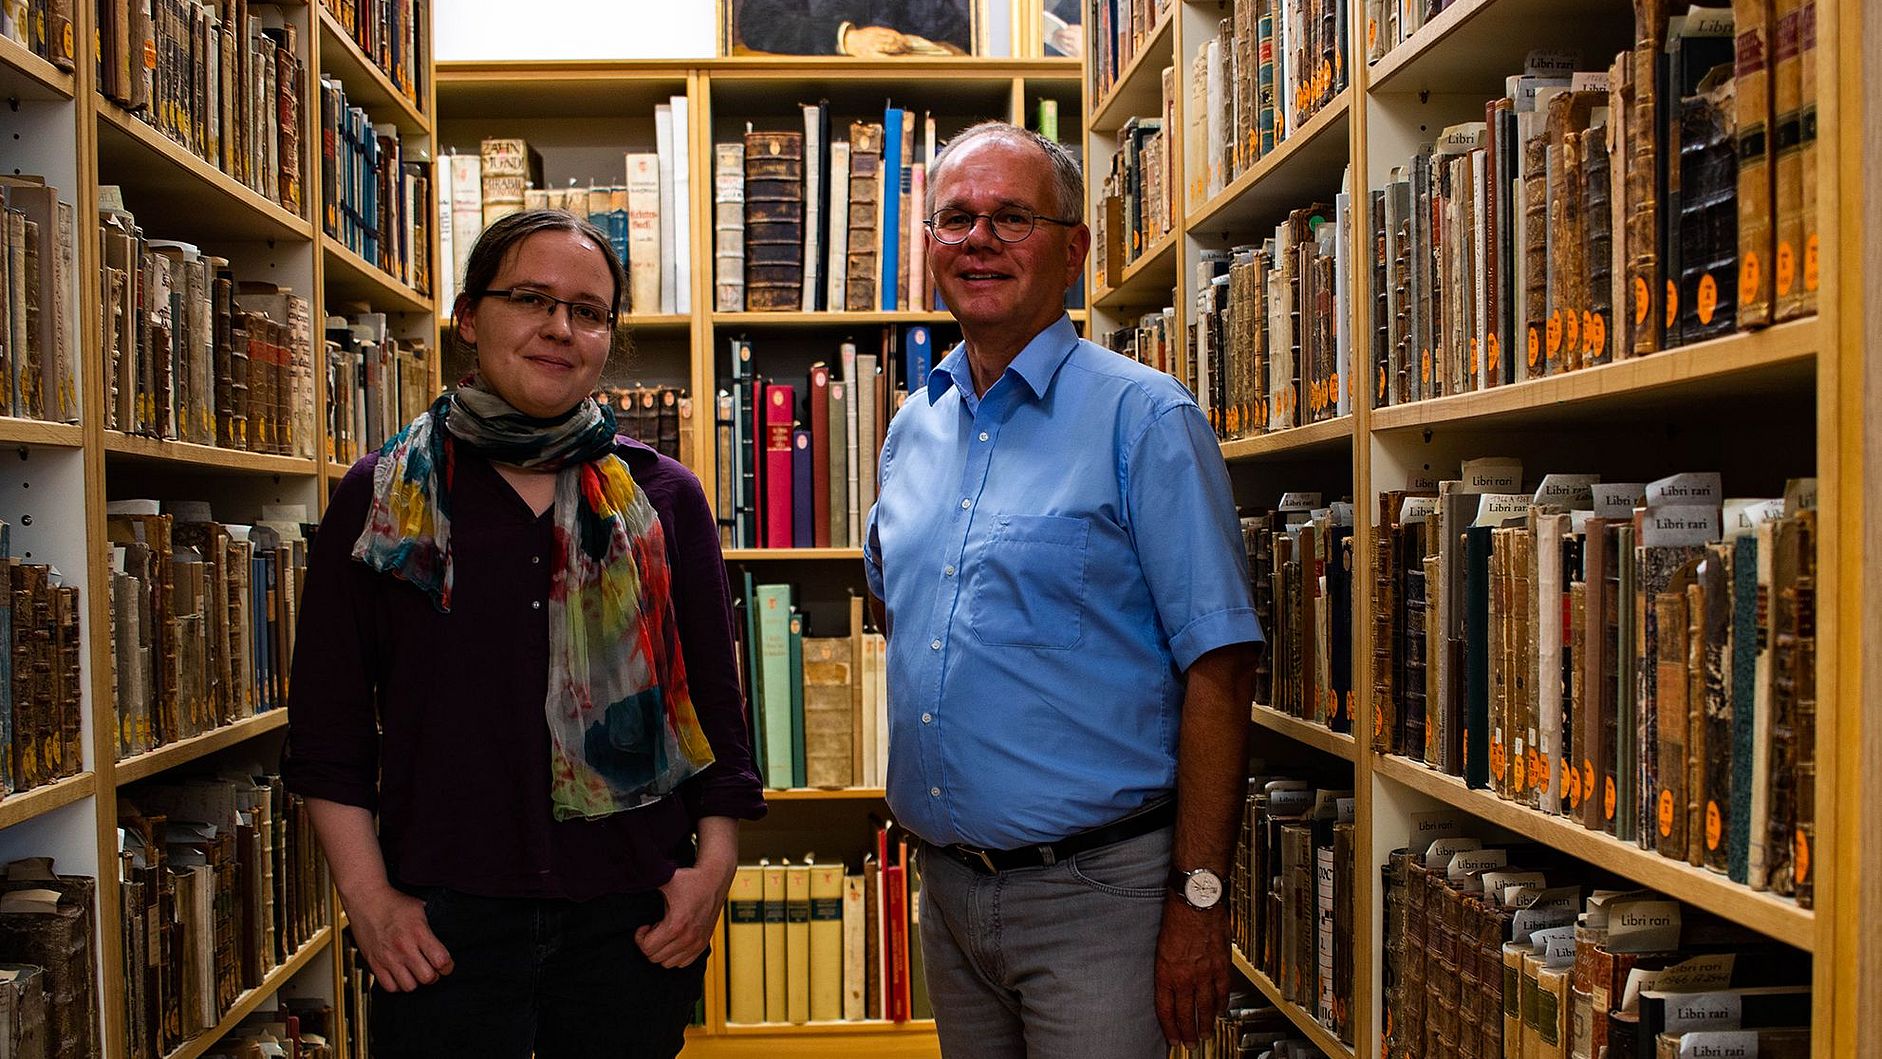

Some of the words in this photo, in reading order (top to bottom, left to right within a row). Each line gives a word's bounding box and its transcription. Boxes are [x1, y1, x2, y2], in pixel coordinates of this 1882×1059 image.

[1531, 57, 1554, 69] Libri
[1556, 58, 1575, 70] rari
[1448, 132, 1474, 144] Libri
[1473, 475, 1493, 486] Libri
[1495, 475, 1513, 486] rari
[1546, 486, 1569, 495] Libri
[1661, 487, 1687, 497] Libri
[1691, 485, 1711, 497] rari
[1606, 496, 1630, 506] Libri
[1489, 503, 1511, 512] Libri
[1656, 518, 1684, 530] Libri
[1687, 518, 1707, 530] rari
[1419, 821, 1437, 831] Libri
[1438, 820, 1454, 830] rari
[1457, 860, 1478, 870] Libri
[1480, 860, 1497, 870] rari
[1523, 921, 1545, 930] Libri
[1621, 914, 1646, 926] Libri
[1649, 914, 1670, 926] rari
[1700, 963, 1722, 972] rari
[1678, 1008, 1705, 1019] Libri
[1709, 1008, 1728, 1018] rari
[1693, 1046, 1720, 1057] Libri
[1724, 1045, 1745, 1056] rari
